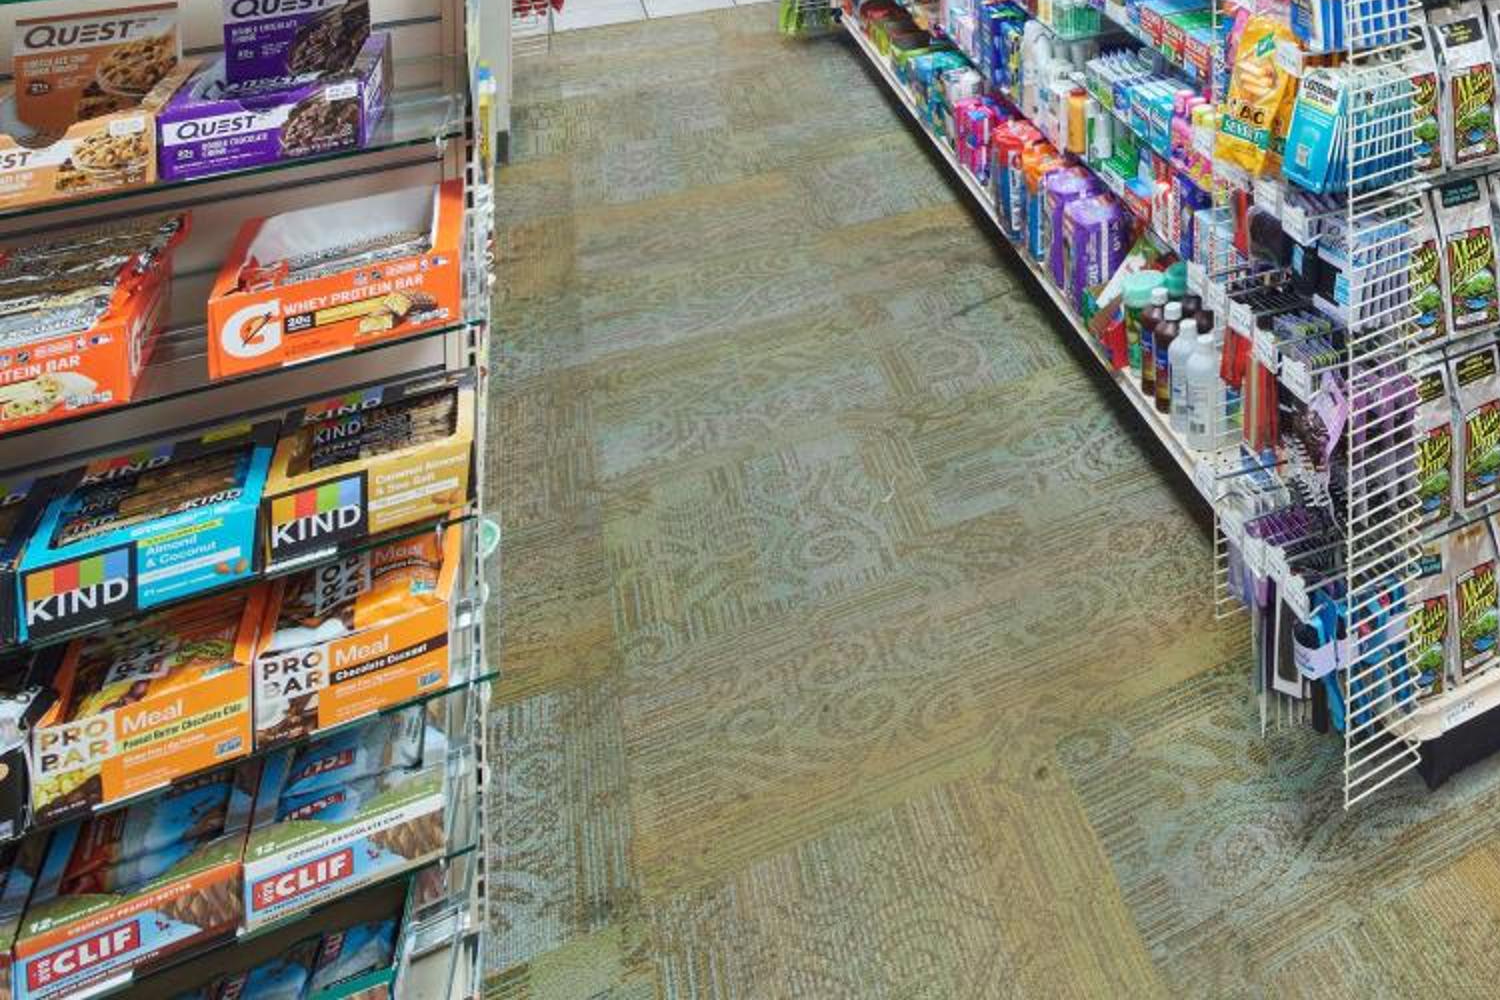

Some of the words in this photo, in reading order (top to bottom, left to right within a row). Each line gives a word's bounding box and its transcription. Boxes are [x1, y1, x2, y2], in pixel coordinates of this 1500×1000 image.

[24, 19, 134, 49] QUEST
[177, 115, 256, 140] QUEST
[283, 296, 329, 316] WHEY
[331, 279, 393, 304] PROTEIN
[395, 274, 424, 291] BAR
[46, 355, 80, 373] BAR
[314, 420, 361, 444] KIND
[273, 504, 361, 548] KIND
[145, 534, 197, 556] Almond
[145, 557, 155, 568] &
[160, 541, 217, 564] Coconut
[27, 577, 129, 627] KIND
[335, 633, 390, 667] Meal
[263, 651, 323, 680] PRO
[335, 655, 385, 681] Chocolate
[263, 670, 323, 699] BAR
[122, 699, 184, 734] Meal
[181, 710, 221, 731] Chocolate
[40, 720, 108, 751] PRO
[40, 740, 109, 773] BAR
[256, 841, 275, 856] 12
[275, 852, 348, 897] CLIF
[117, 896, 154, 917] PEANUT
[30, 917, 53, 933] 12
[52, 927, 131, 973] CLIF
